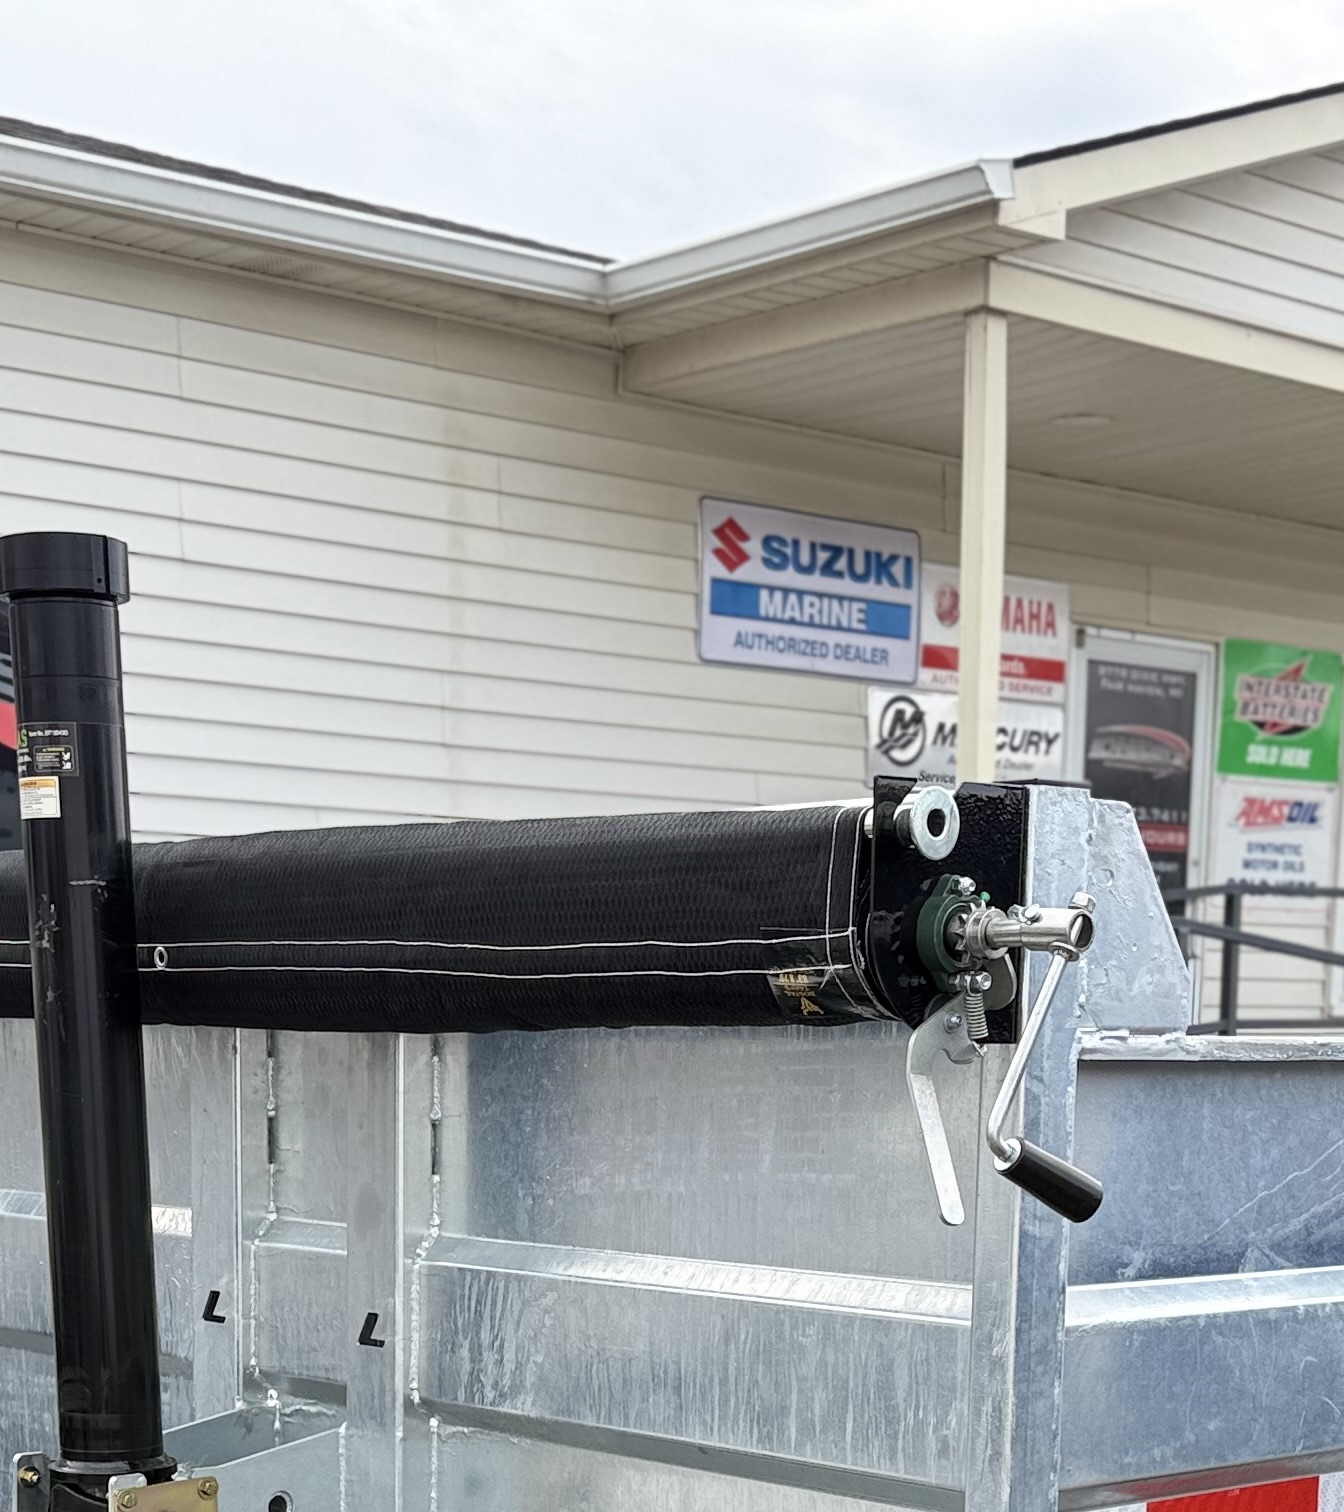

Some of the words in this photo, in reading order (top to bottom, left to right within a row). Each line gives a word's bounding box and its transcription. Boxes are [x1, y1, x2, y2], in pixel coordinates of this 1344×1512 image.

[761, 534, 913, 589] SUZUKI
[759, 588, 868, 631] MARINE
[733, 630, 830, 659] AUTHORIZED
[833, 644, 890, 666] DEALER
[1239, 679, 1328, 705] INTERSTATE
[1240, 701, 1321, 724] BATTERIES
[932, 721, 1061, 756] MCURY
[1235, 795, 1321, 829] AMSOIL
